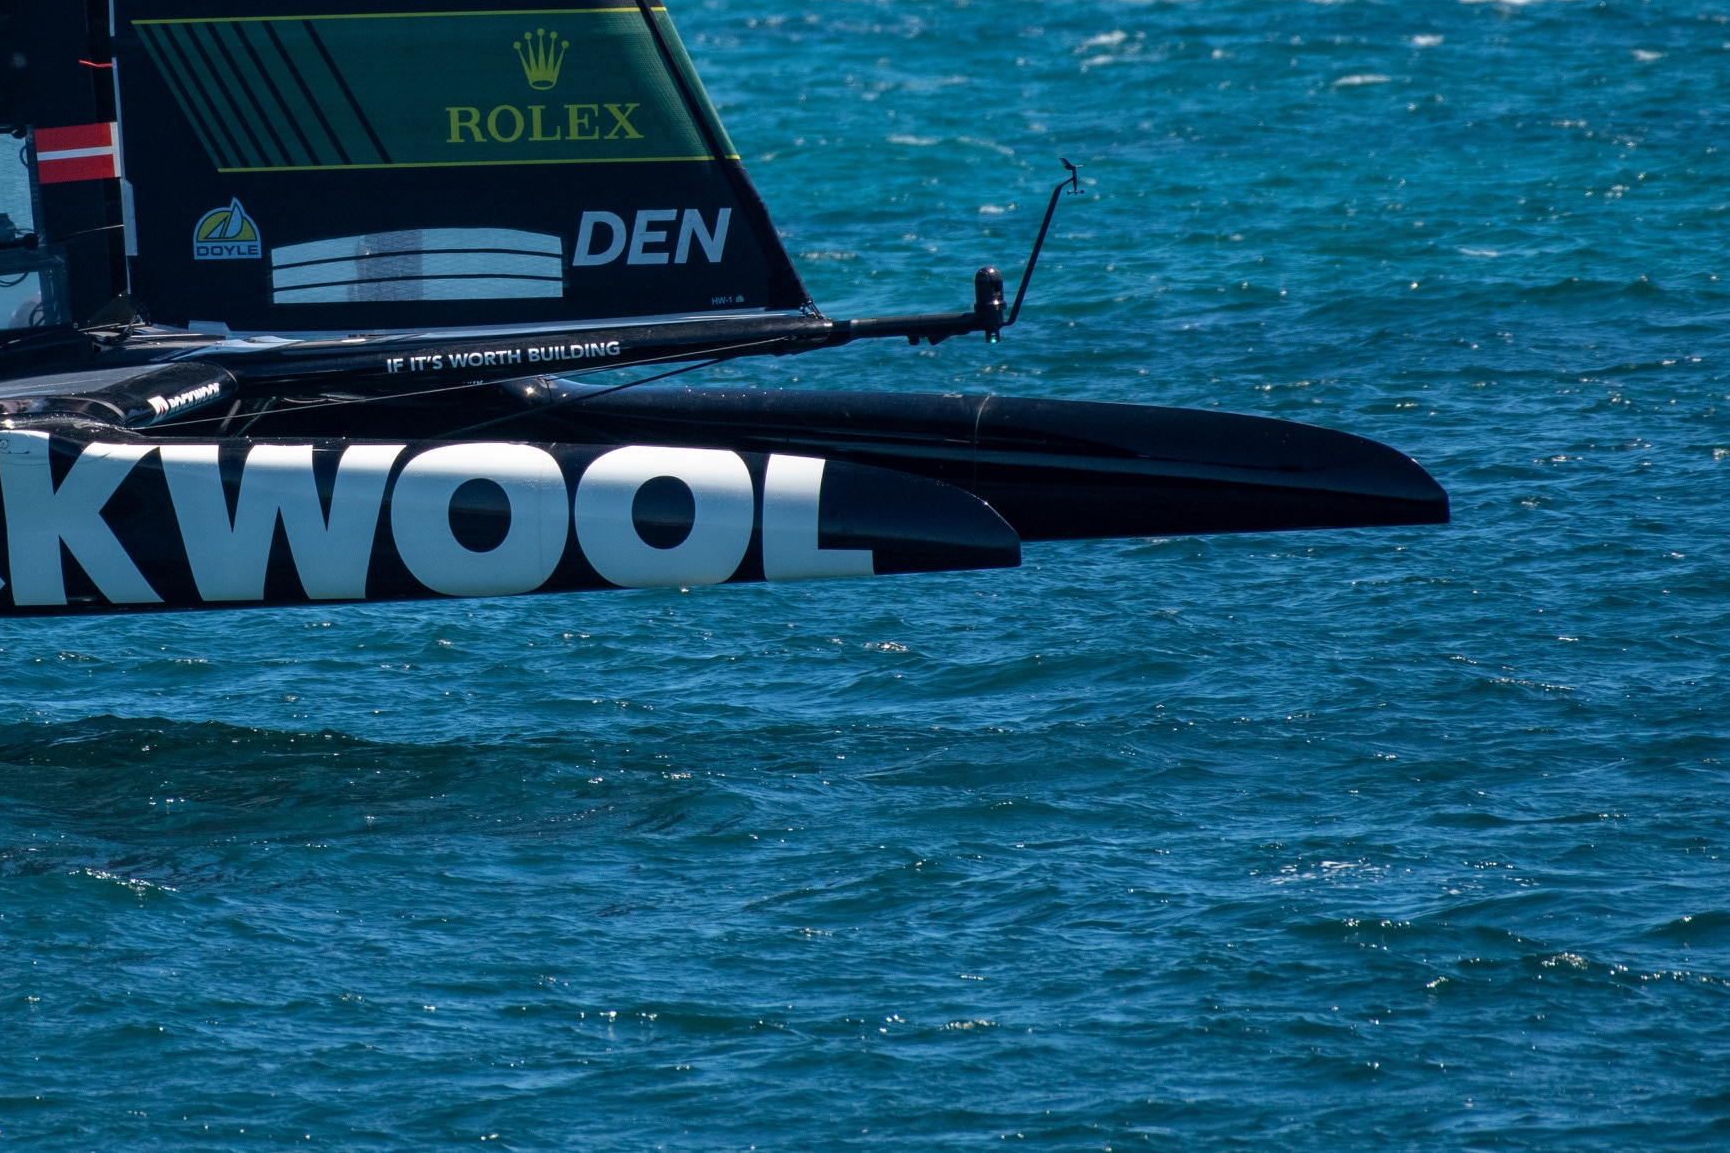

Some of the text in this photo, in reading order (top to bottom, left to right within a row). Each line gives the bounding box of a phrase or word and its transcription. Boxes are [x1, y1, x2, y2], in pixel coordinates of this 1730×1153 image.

[445, 102, 644, 144] ROLEX
[196, 244, 259, 257] DOYLE
[572, 207, 732, 267] DEN
[386, 341, 621, 374] IF IT'S WORTH BUILDING
